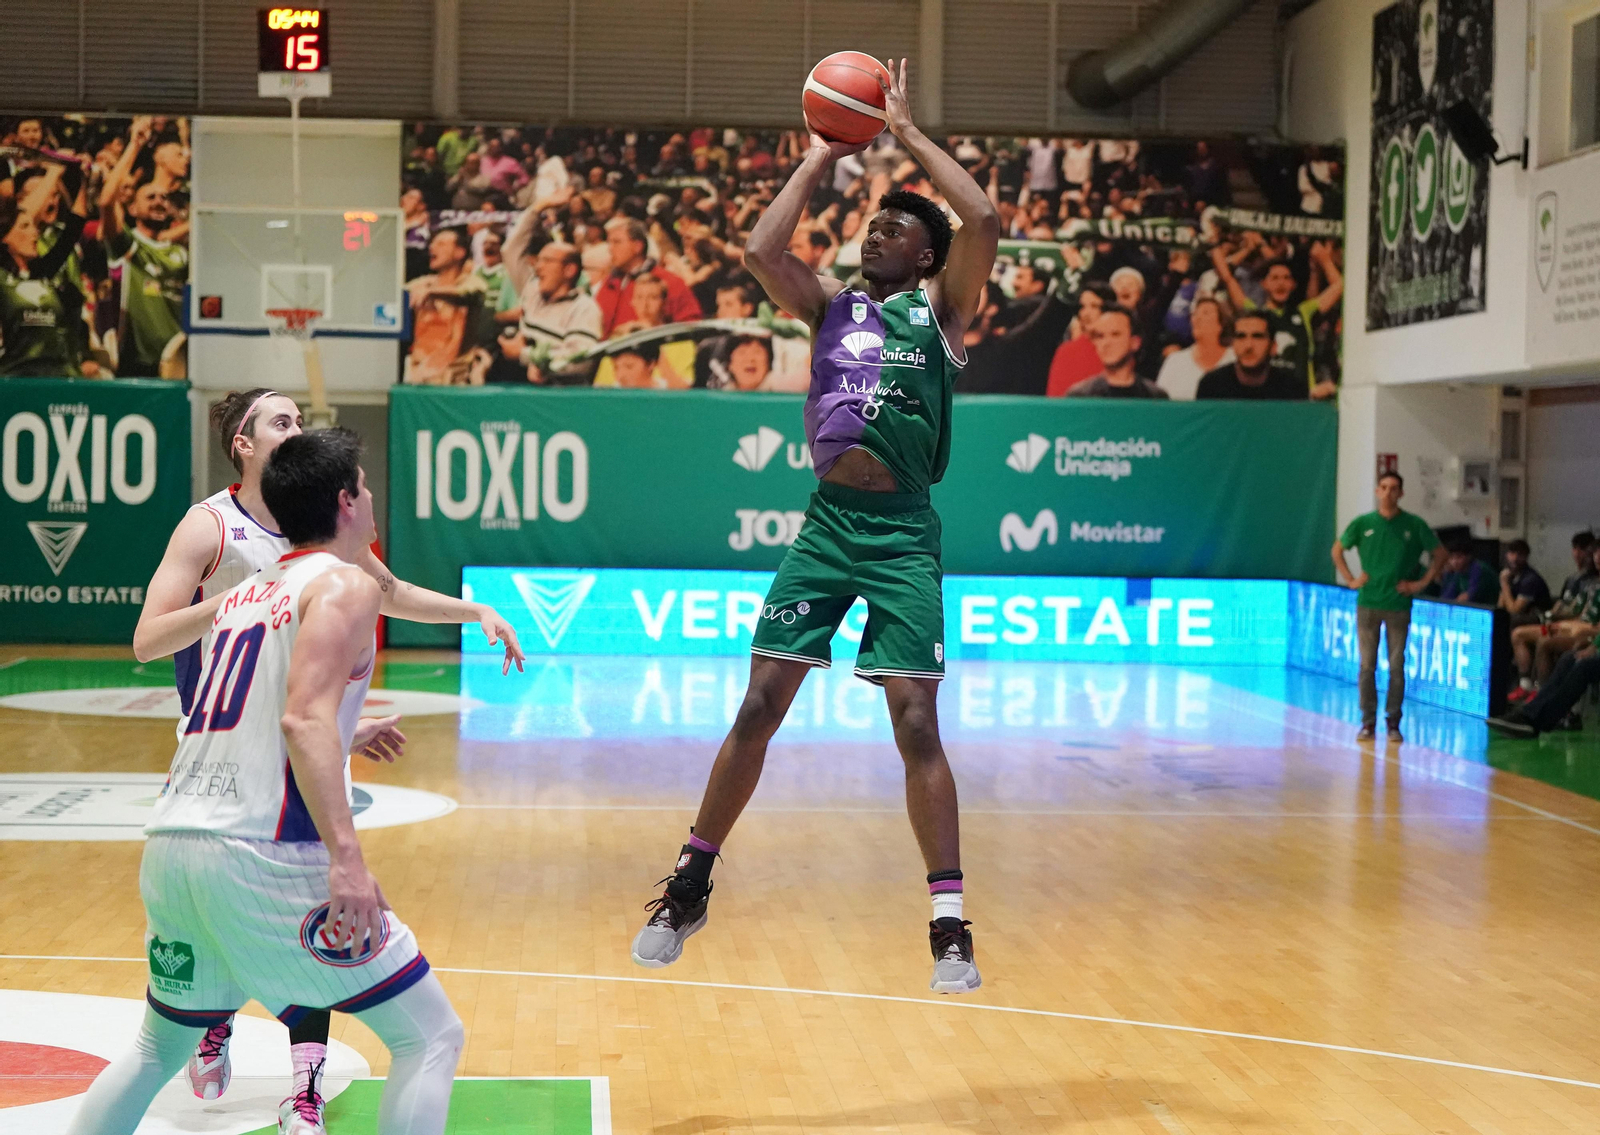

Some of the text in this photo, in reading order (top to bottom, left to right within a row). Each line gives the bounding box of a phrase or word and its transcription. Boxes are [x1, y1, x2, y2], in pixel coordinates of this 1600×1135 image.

[285, 34, 320, 71] 15
[880, 347, 926, 365] Unicaja
[1055, 436, 1161, 458] Fundación
[1055, 457, 1132, 481] Unicaja
[1070, 521, 1165, 543] Movistar
[67, 585, 145, 605] ESTATE
[960, 595, 1214, 646] ESTATE
[1407, 622, 1471, 690] STATE
[184, 622, 266, 735] 10
[184, 774, 238, 798] ZUBIA
